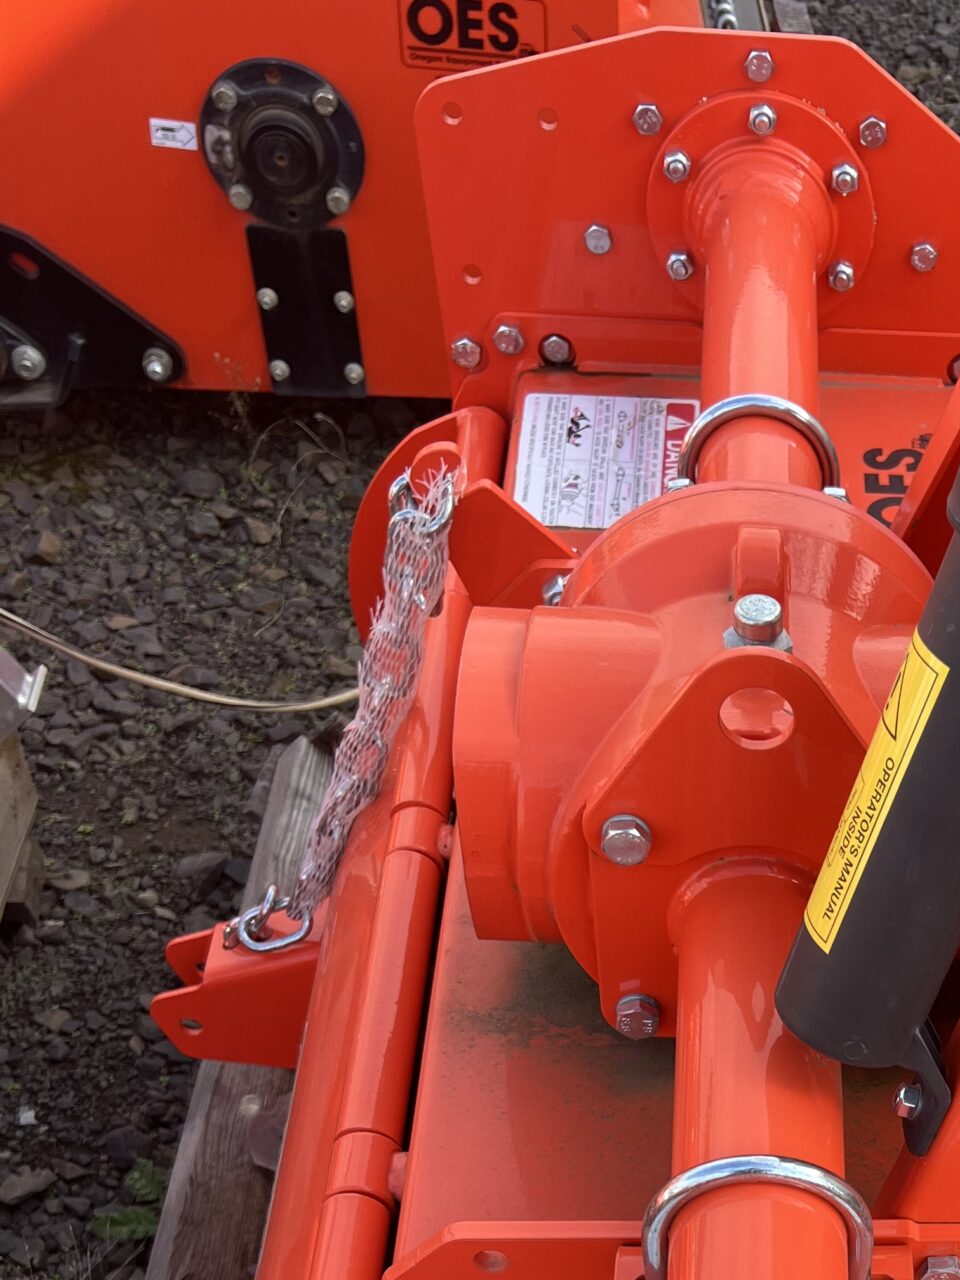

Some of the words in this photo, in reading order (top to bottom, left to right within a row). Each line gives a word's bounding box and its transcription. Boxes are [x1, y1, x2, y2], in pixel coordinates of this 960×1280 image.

[407, 0, 519, 52] OES
[838, 805, 863, 861] INSIDE
[849, 757, 895, 858] OPERATOR'S
[822, 858, 854, 921] MANUAL
